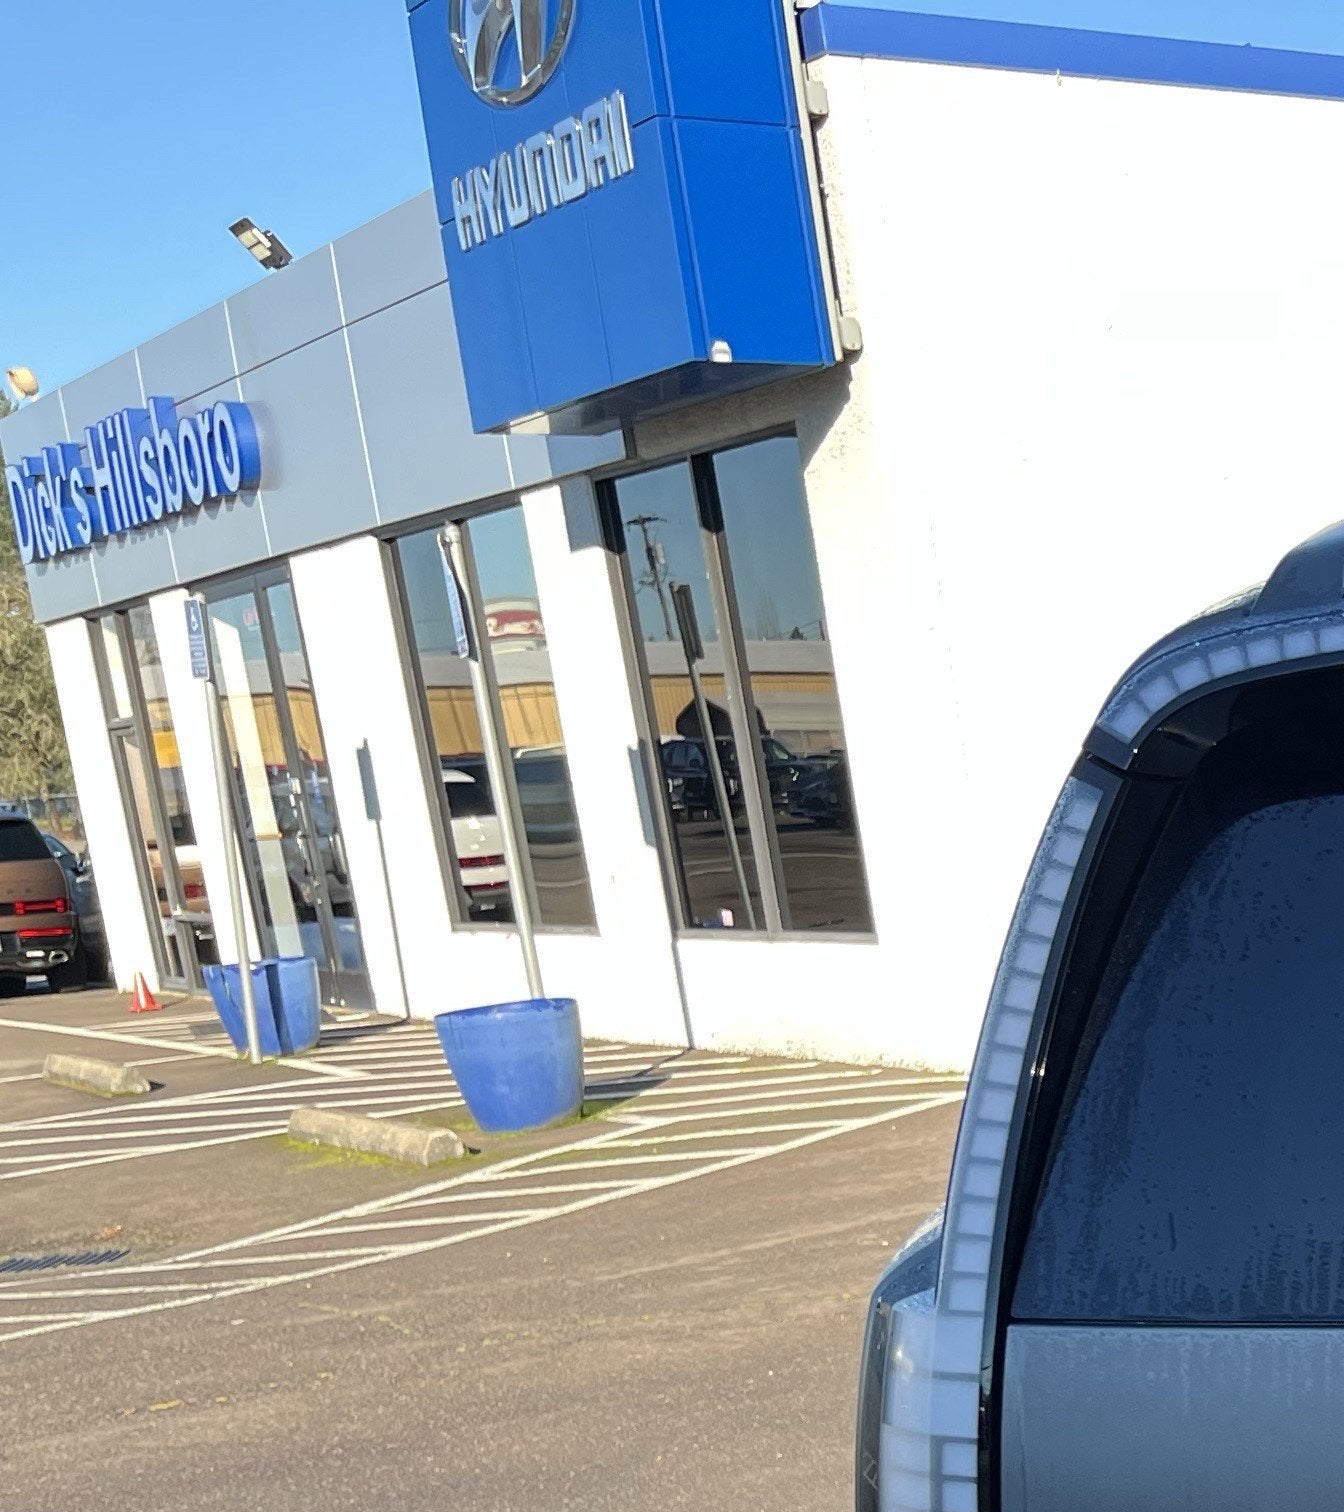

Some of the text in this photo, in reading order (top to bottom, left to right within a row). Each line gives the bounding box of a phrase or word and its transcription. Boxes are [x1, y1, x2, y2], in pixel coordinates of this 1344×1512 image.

[452, 90, 635, 252] HYUNDAI
[5, 397, 241, 564] Dick's Hillsboro
